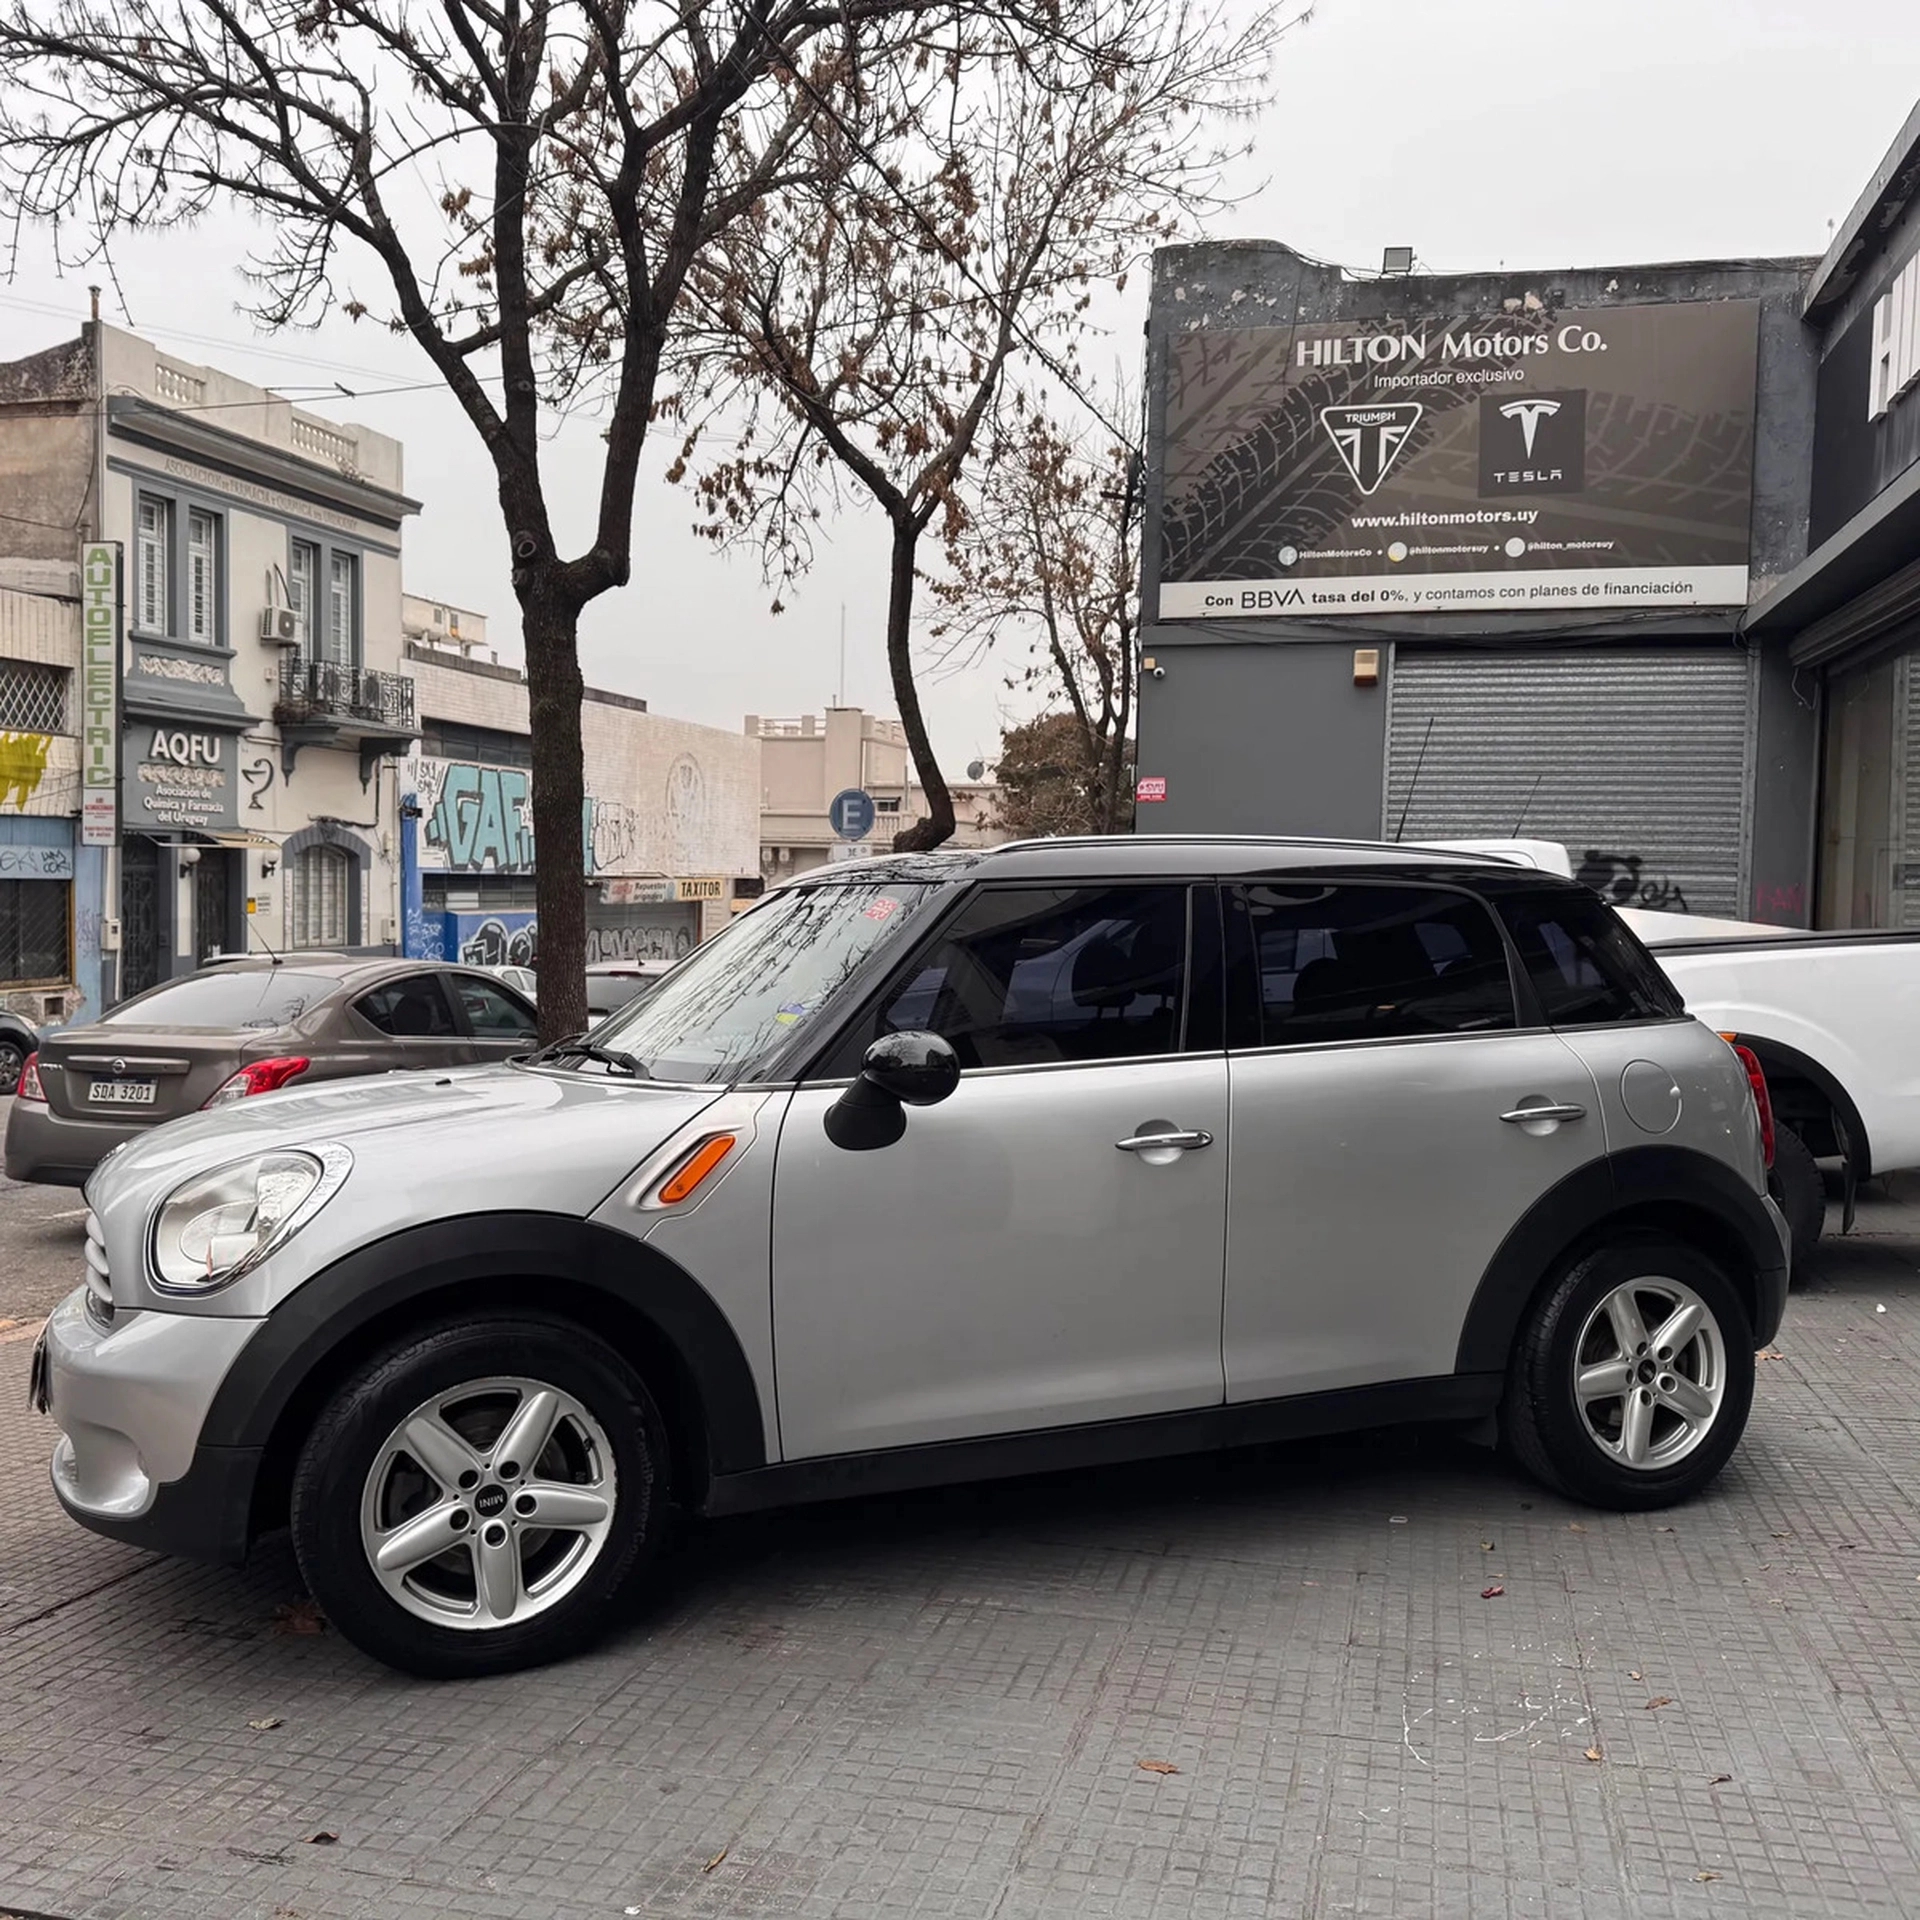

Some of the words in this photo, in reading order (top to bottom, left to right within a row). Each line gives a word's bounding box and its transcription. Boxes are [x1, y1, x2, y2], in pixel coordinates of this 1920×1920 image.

[1296, 334, 1426, 367] HILTON
[1441, 332, 1549, 359] Motors
[1557, 325, 1608, 353] Co.
[1373, 371, 1452, 389] Importador
[1456, 368, 1525, 383] exclusivo
[1345, 411, 1396, 424] TRIUMPH
[1493, 469, 1562, 483] TESLA
[1351, 509, 1539, 528] www.hiltonmotors.uy
[1205, 595, 1234, 606] Con
[1241, 588, 1305, 609] BBVA
[1312, 592, 1346, 604] tasa
[1351, 590, 1375, 602] del
[1413, 591, 1422, 603] y
[1426, 588, 1495, 601] contamos
[1500, 587, 1526, 598] con
[1530, 584, 1577, 600] planes
[1582, 583, 1600, 596] de
[1604, 581, 1694, 595] financiación
[86, 548, 112, 785] AUTOELECTRIC
[150, 730, 220, 765] AQFU
[201, 787, 212, 798] de
[842, 799, 861, 830] E
[681, 880, 721, 897] TAXITOR
[120, 1085, 151, 1100] 3201
